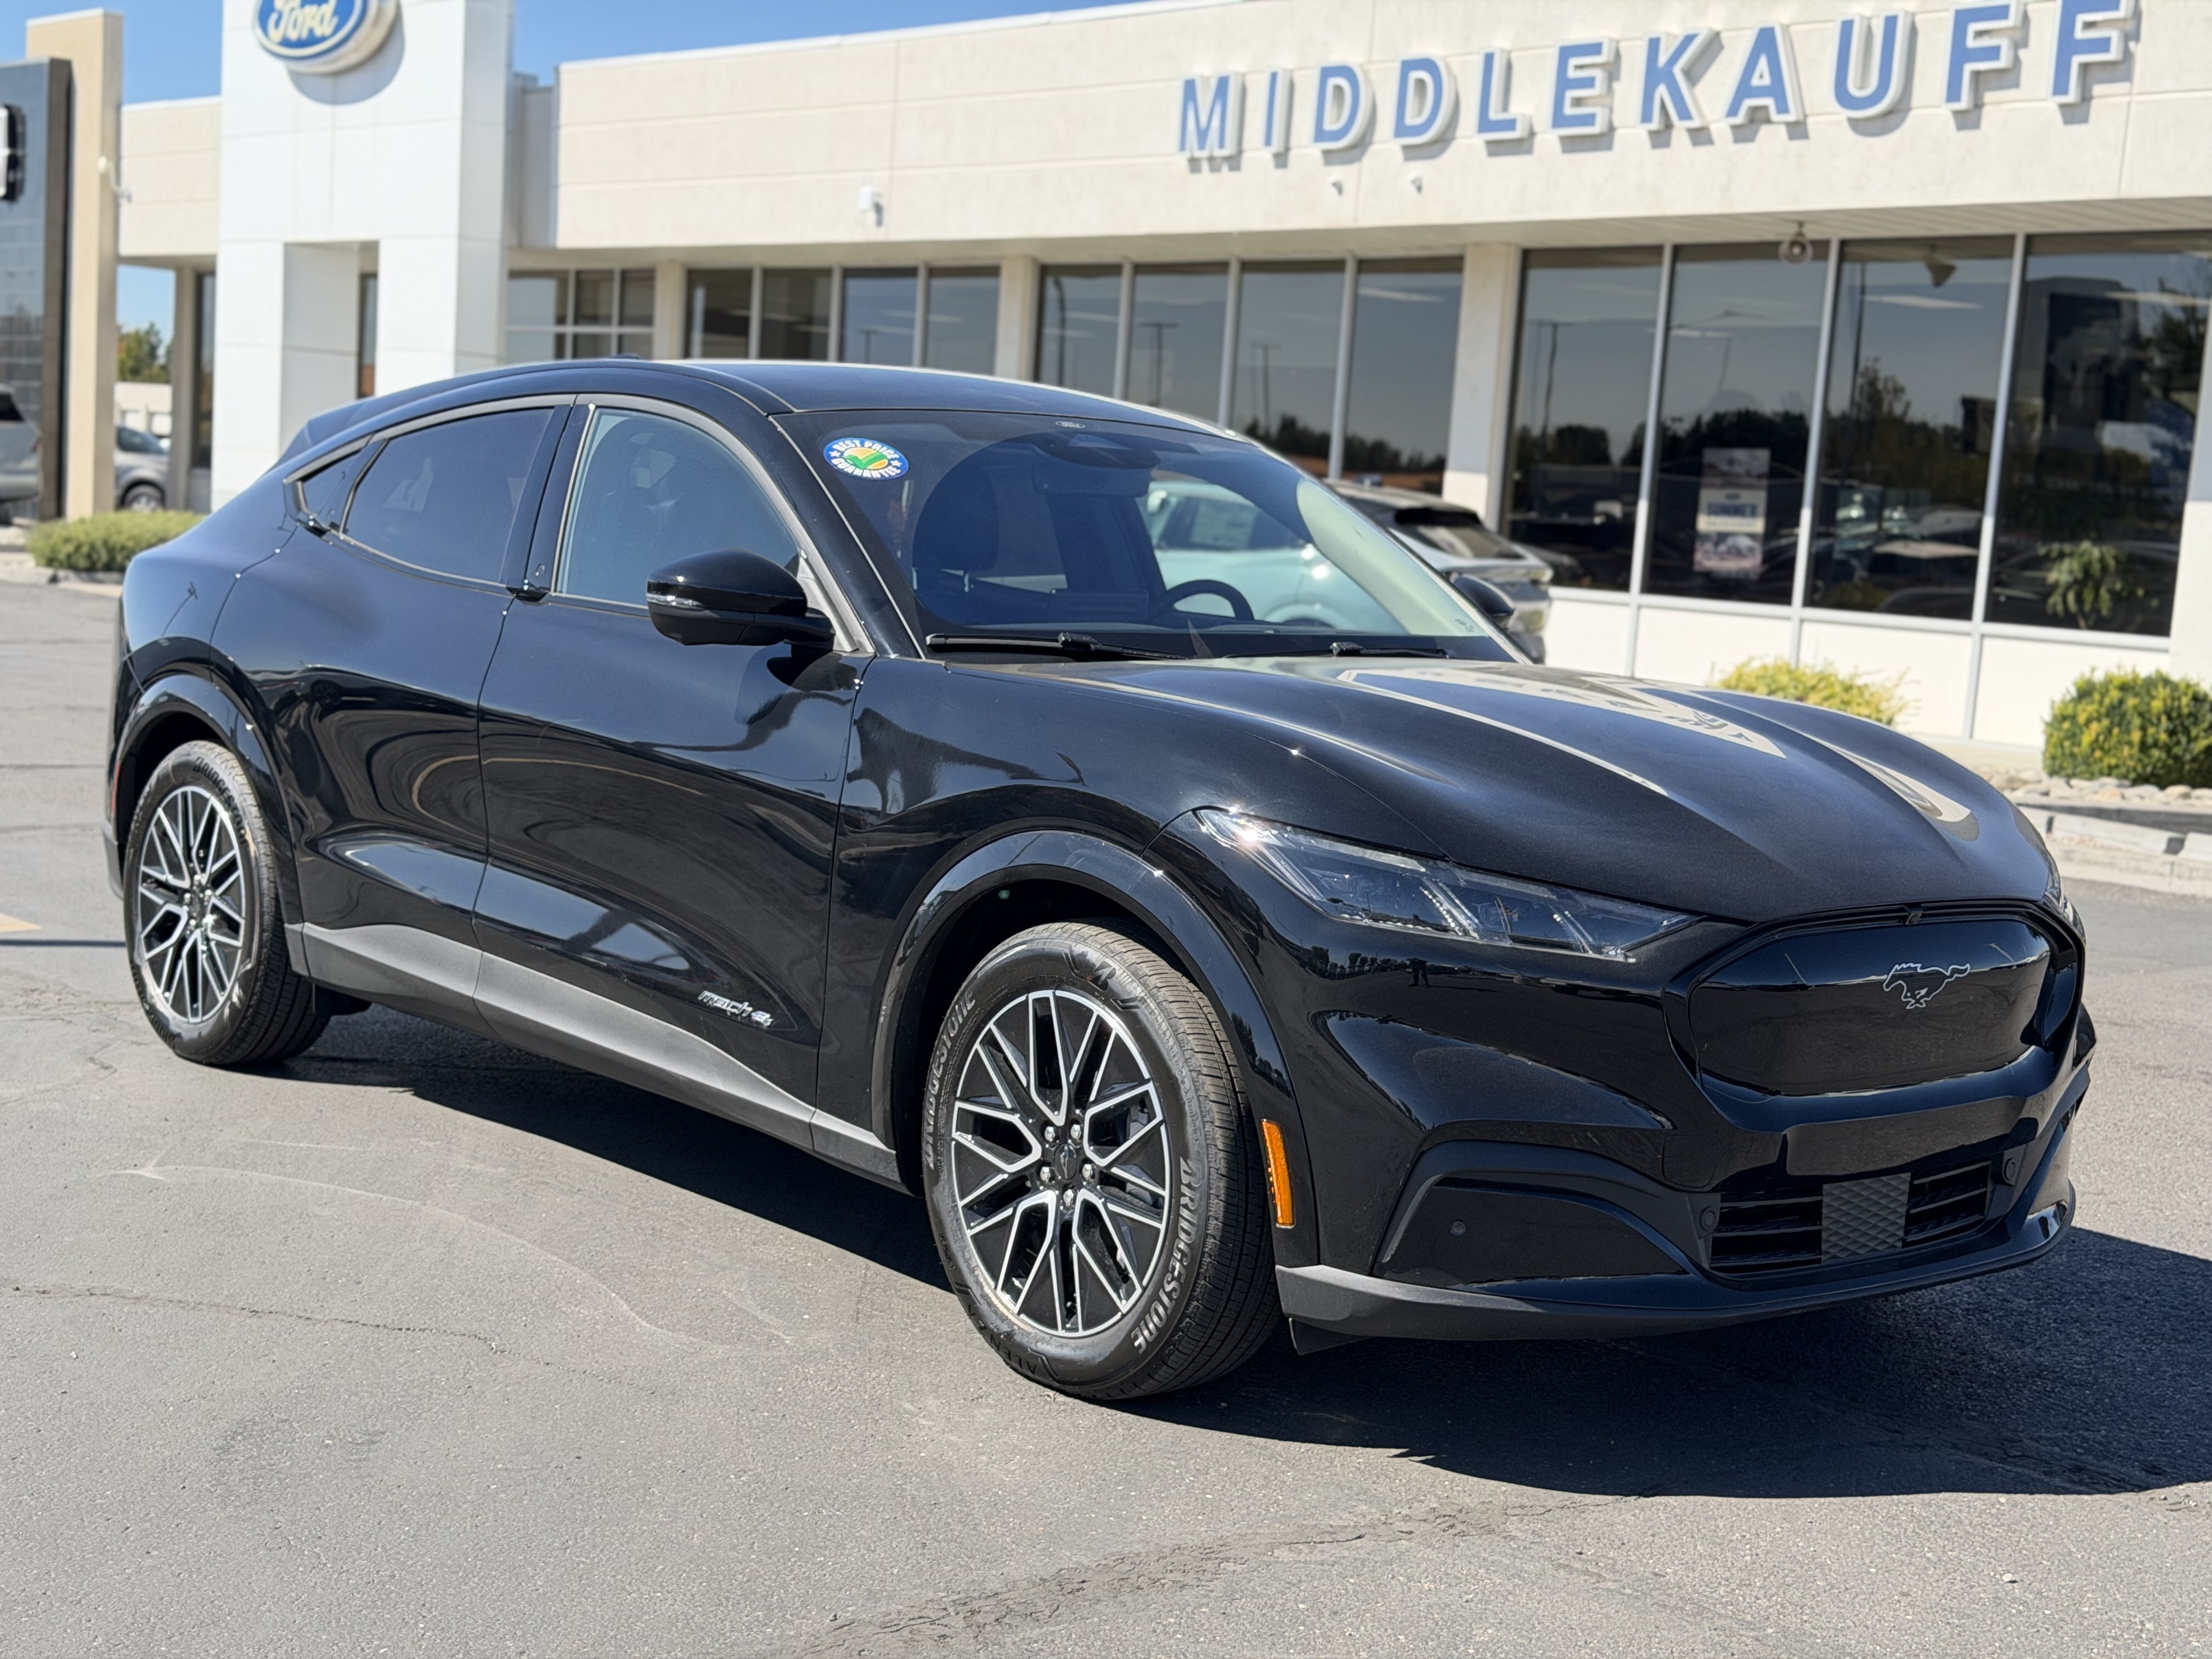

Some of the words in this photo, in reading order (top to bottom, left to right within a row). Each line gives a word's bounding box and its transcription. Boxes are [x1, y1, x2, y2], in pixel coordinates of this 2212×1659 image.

[267, 0, 339, 43] Ford
[1178, 0, 2125, 156] MIDDLEKAUFF
[832, 439, 861, 452] BEST
[864, 441, 900, 459] PRICE
[925, 990, 975, 1170] BRIDGESTONE
[1131, 1156, 1203, 1355] BRIDGESTONE
